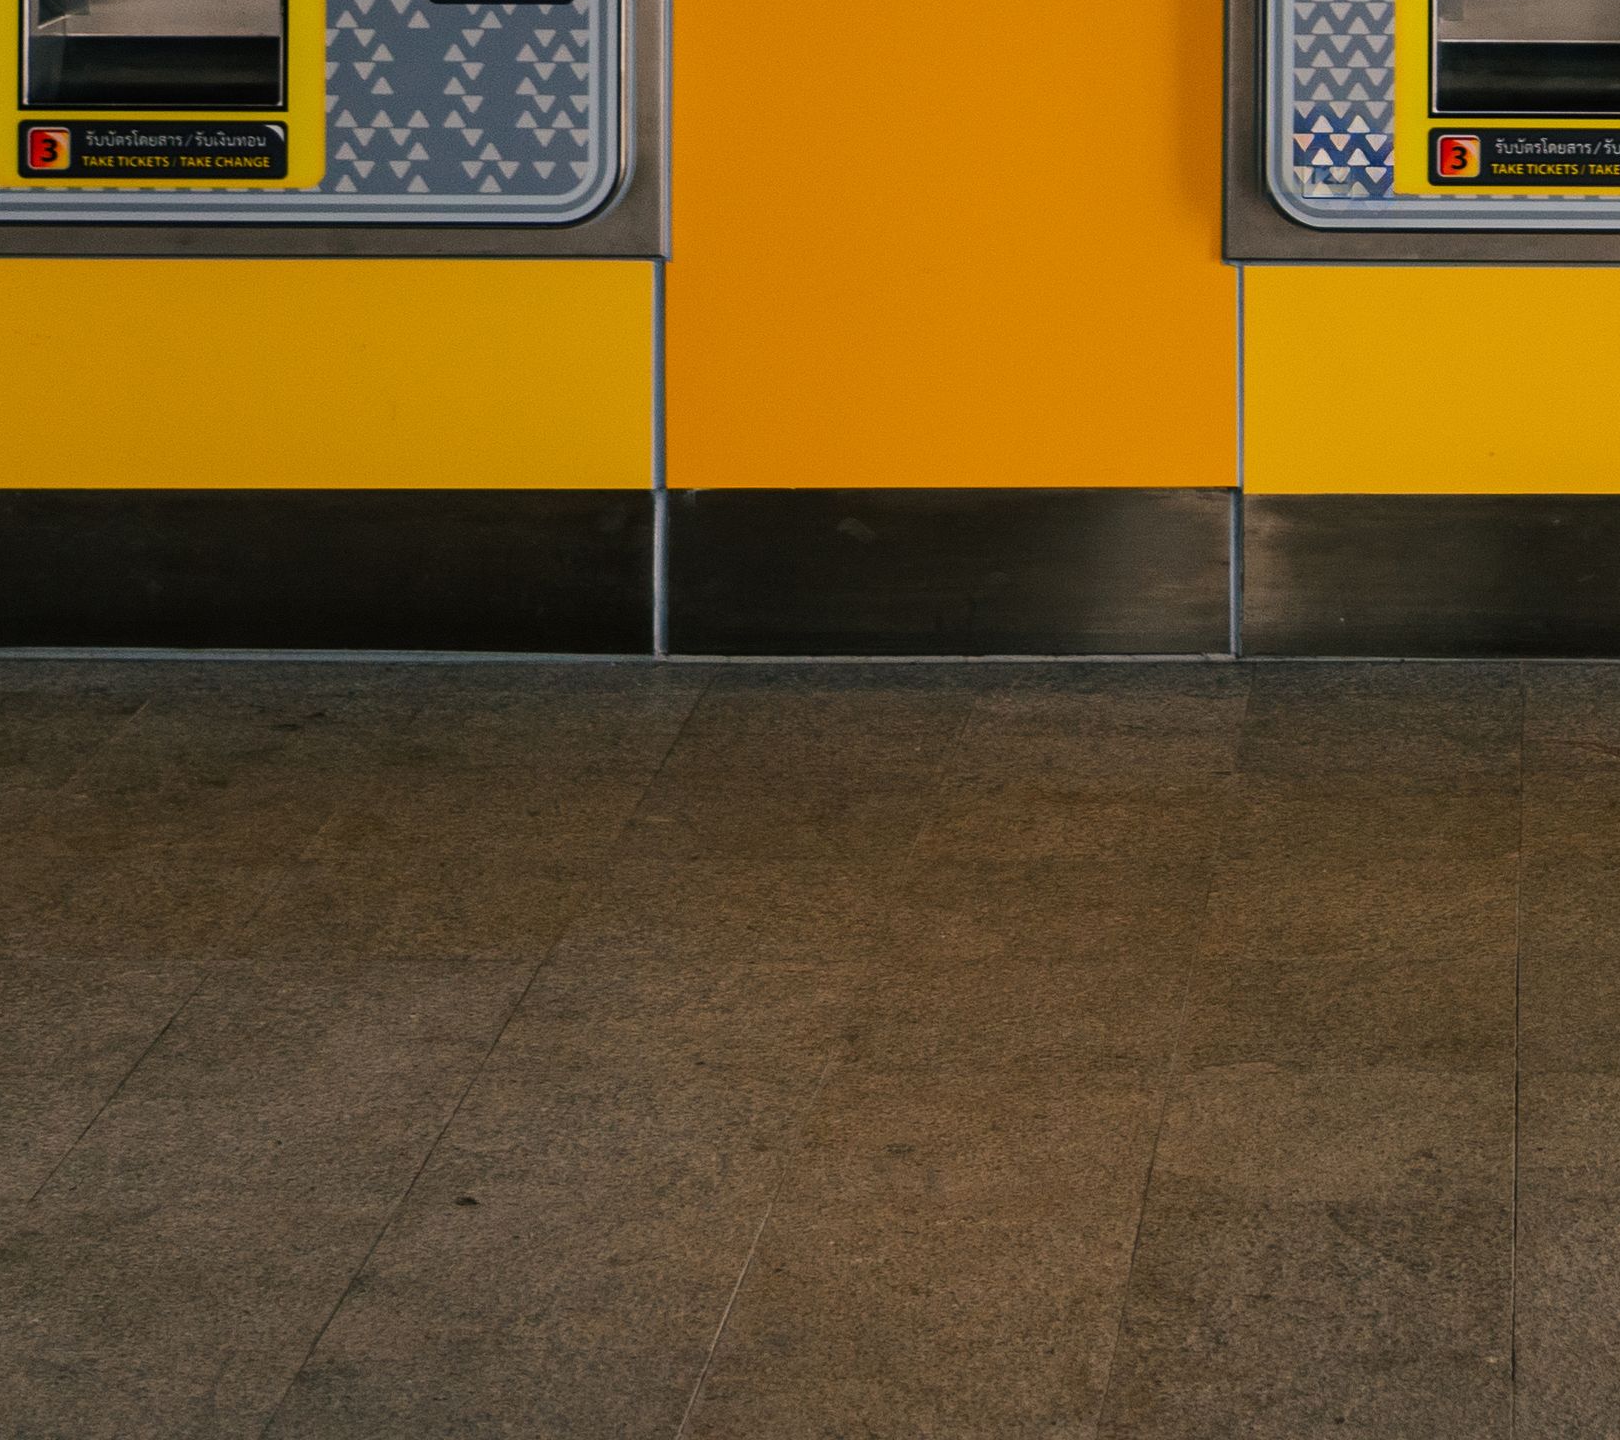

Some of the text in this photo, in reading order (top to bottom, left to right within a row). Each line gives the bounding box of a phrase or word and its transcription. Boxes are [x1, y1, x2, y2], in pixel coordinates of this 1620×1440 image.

[85, 129, 183, 147] รับบัตรโดยสาร
[195, 131, 267, 147] รับเงินทอน
[1494, 137, 1592, 155] รับบัตรโดยสาร
[40, 139, 58, 162] 3
[1450, 147, 1468, 170] 3
[82, 156, 115, 167] TAKE
[118, 156, 170, 167] TICKETS
[180, 156, 212, 167] TAKE
[215, 156, 270, 168] CHANGE
[1491, 164, 1524, 175] TAKE
[1527, 164, 1579, 175] TICKETS
[1589, 164, 1620, 175] TAKE
